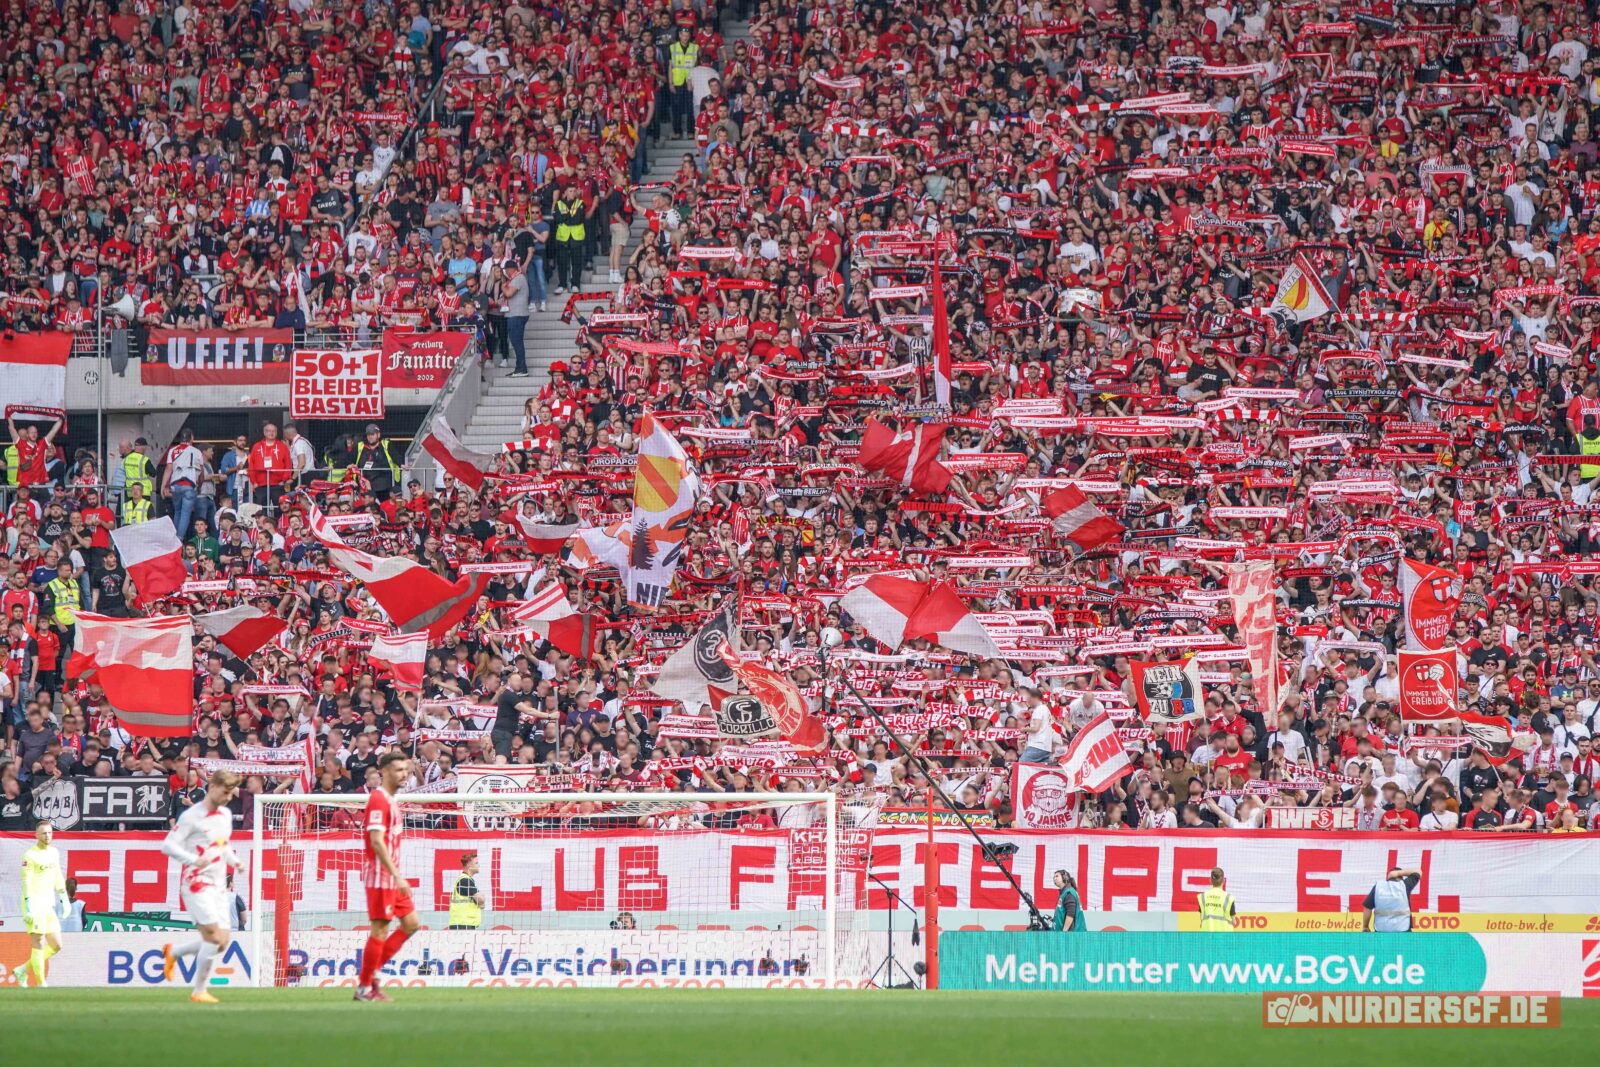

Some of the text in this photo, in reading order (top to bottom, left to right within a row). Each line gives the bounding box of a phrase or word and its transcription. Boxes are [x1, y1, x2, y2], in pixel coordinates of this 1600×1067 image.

[411, 340, 444, 350] Freiburg
[295, 351, 378, 377] 50+1
[294, 378, 380, 396] BLEIBT.
[294, 397, 378, 415] BASTA!
[1144, 664, 1184, 683] NEIN
[1150, 698, 1168, 714] ZU
[719, 716, 776, 735] CORRILLO
[84, 785, 134, 815] FA
[1036, 811, 1073, 825] JAHRE
[1295, 918, 1362, 930] lotto-bw.de
[1413, 916, 1555, 931] LOTTO lotto-bw.de
[985, 953, 1426, 985] Mehr unter www.BGV.de
